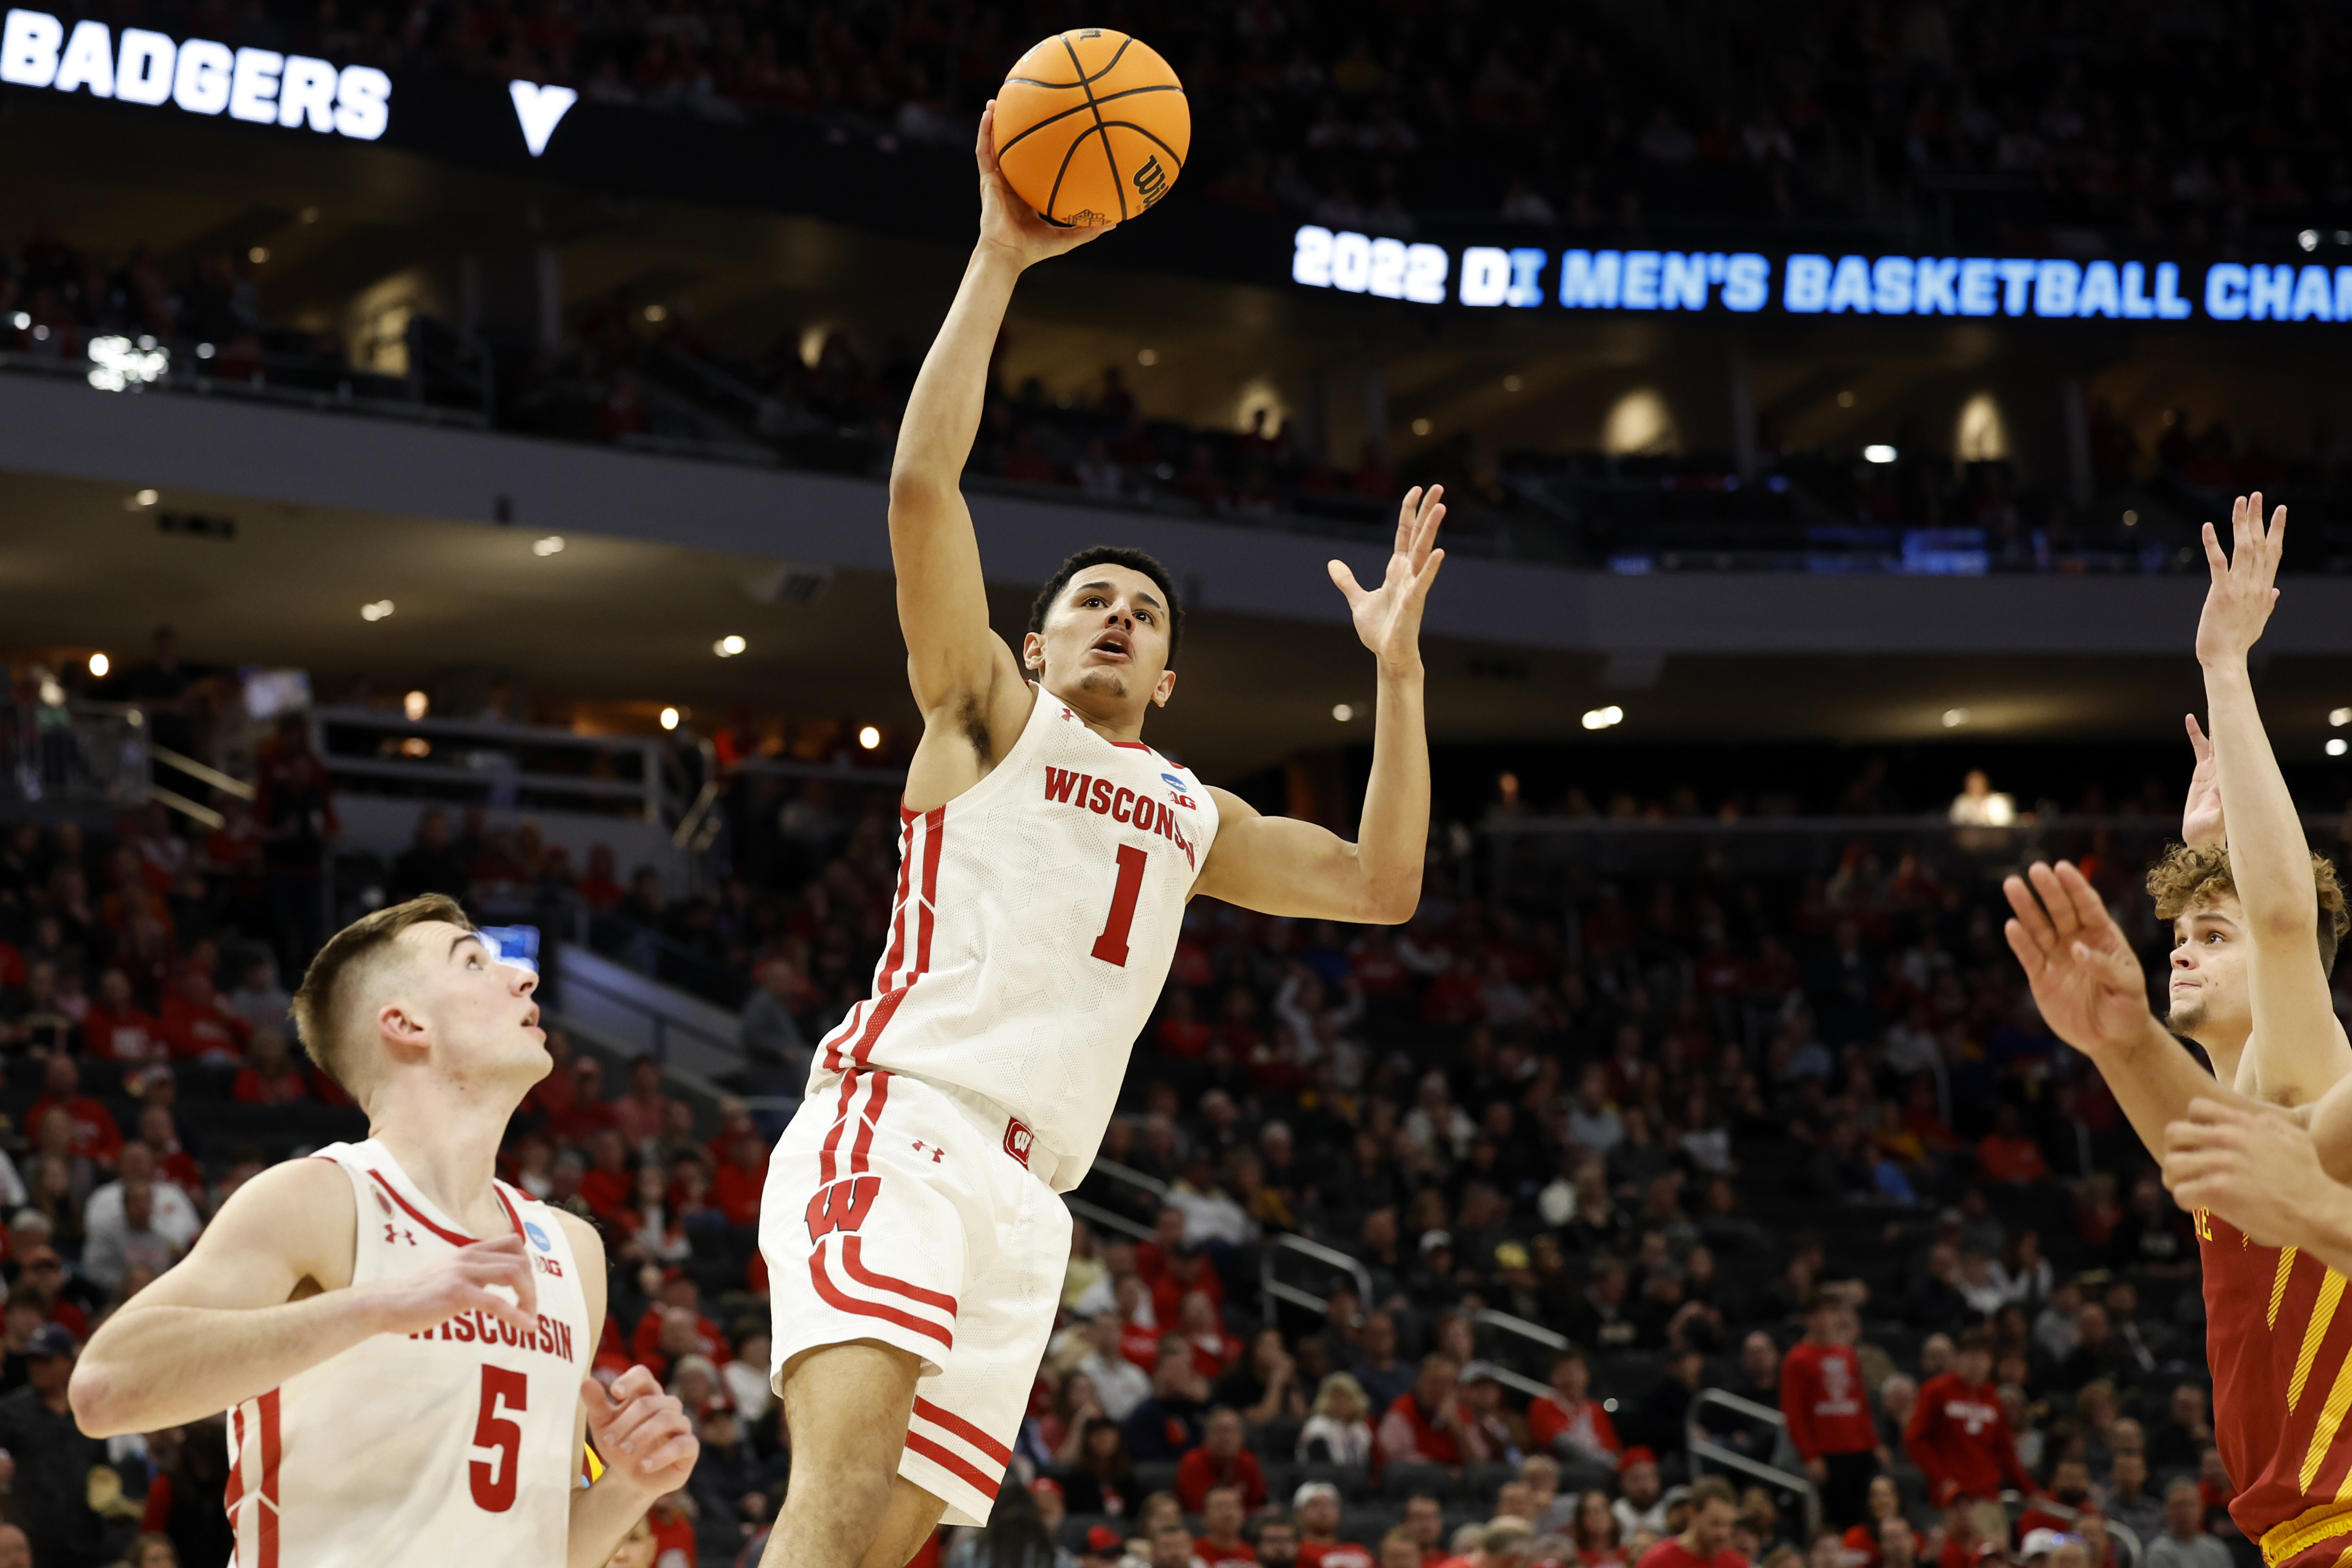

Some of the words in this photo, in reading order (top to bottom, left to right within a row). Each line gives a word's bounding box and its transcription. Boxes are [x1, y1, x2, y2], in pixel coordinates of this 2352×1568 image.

[0, 8, 392, 140] BADGERS
[1292, 224, 1449, 304] 2022
[1559, 249, 1771, 312] MEN'S
[1783, 254, 2192, 320] BASKETBALL
[1091, 843, 1147, 967] 1
[469, 1364, 527, 1513] 5
